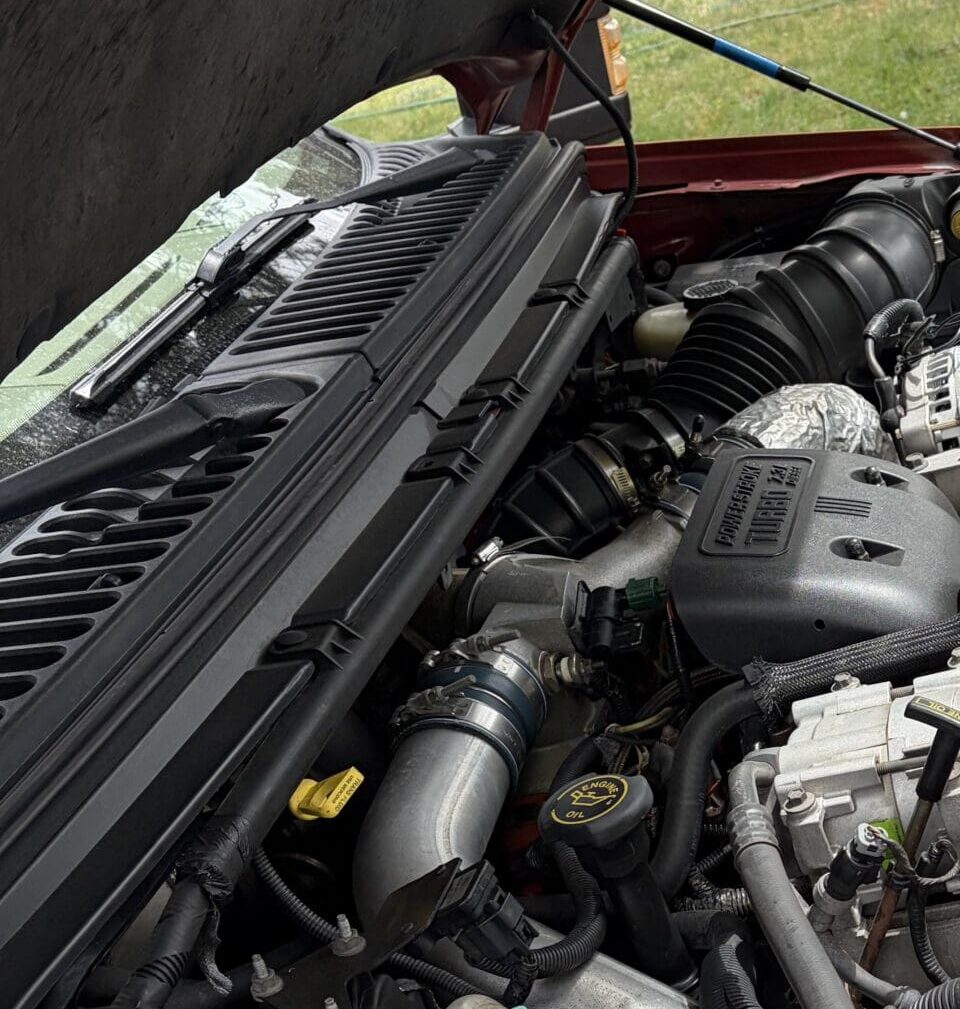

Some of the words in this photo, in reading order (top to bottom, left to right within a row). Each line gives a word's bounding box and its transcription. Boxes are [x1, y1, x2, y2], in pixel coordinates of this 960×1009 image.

[715, 462, 762, 547] POWERSTROKE
[744, 488, 792, 547] TURBO
[928, 701, 946, 711] OIL
[581, 780, 620, 795] ENGINE
[565, 809, 585, 819] OIL
